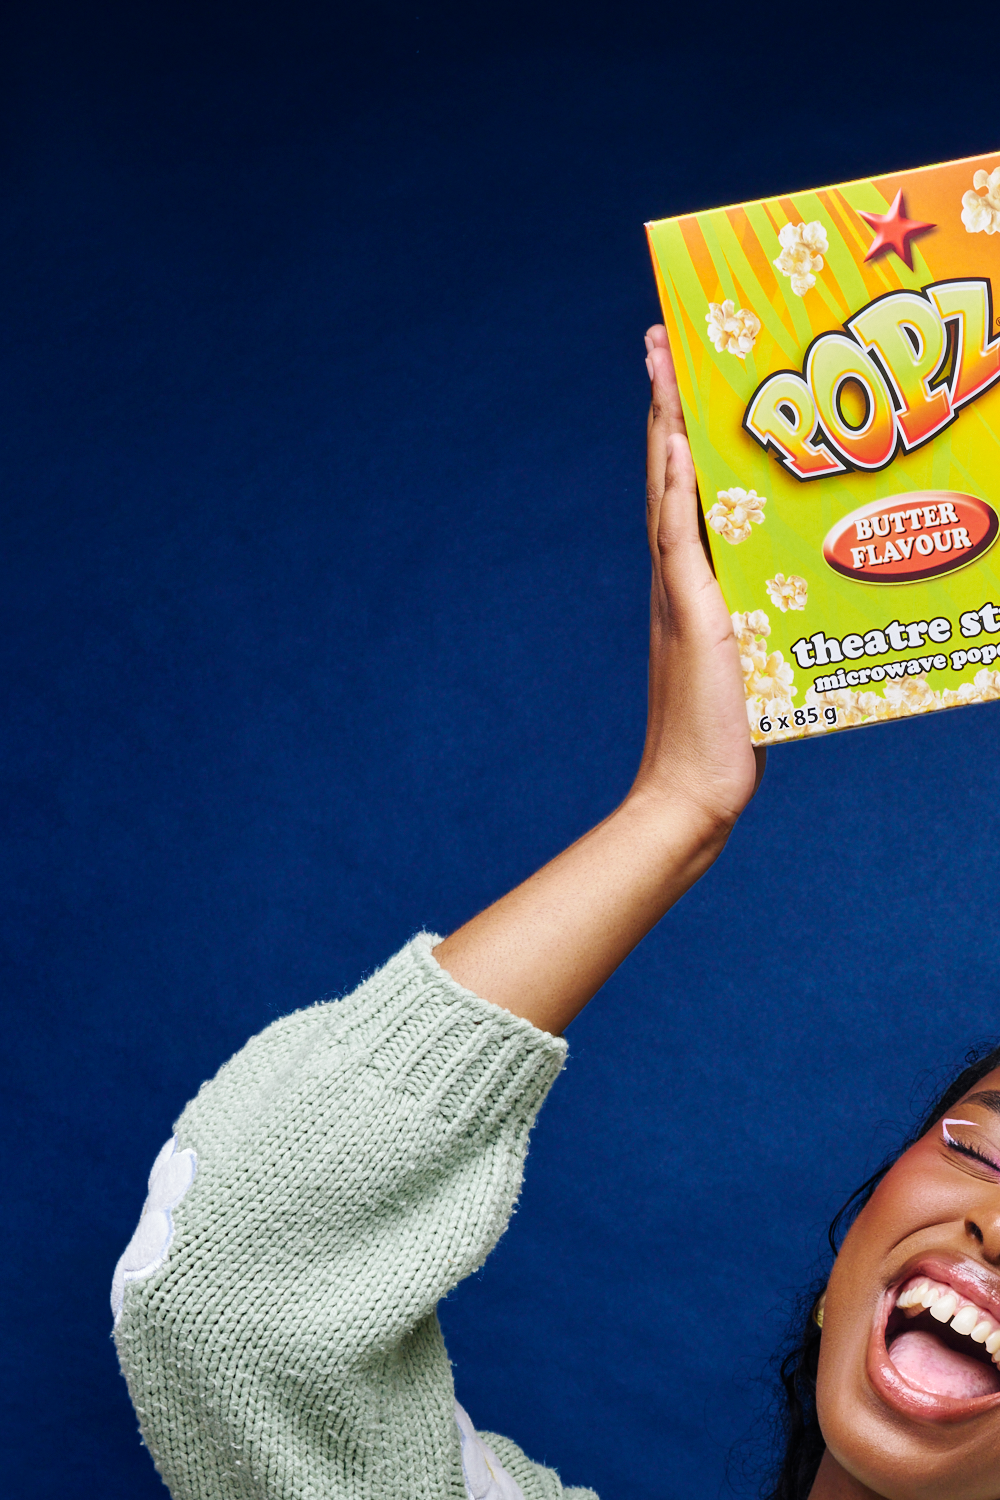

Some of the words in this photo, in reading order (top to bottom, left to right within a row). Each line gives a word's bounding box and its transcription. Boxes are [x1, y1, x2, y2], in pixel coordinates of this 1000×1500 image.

[854, 502, 960, 541] BUTTER
[850, 527, 973, 569] FLAVOUR
[791, 617, 952, 669] theatre
[814, 654, 948, 693] microwave
[759, 715, 772, 733] 6
[777, 716, 790, 730] x
[793, 707, 819, 726] 85
[824, 707, 837, 725] g
